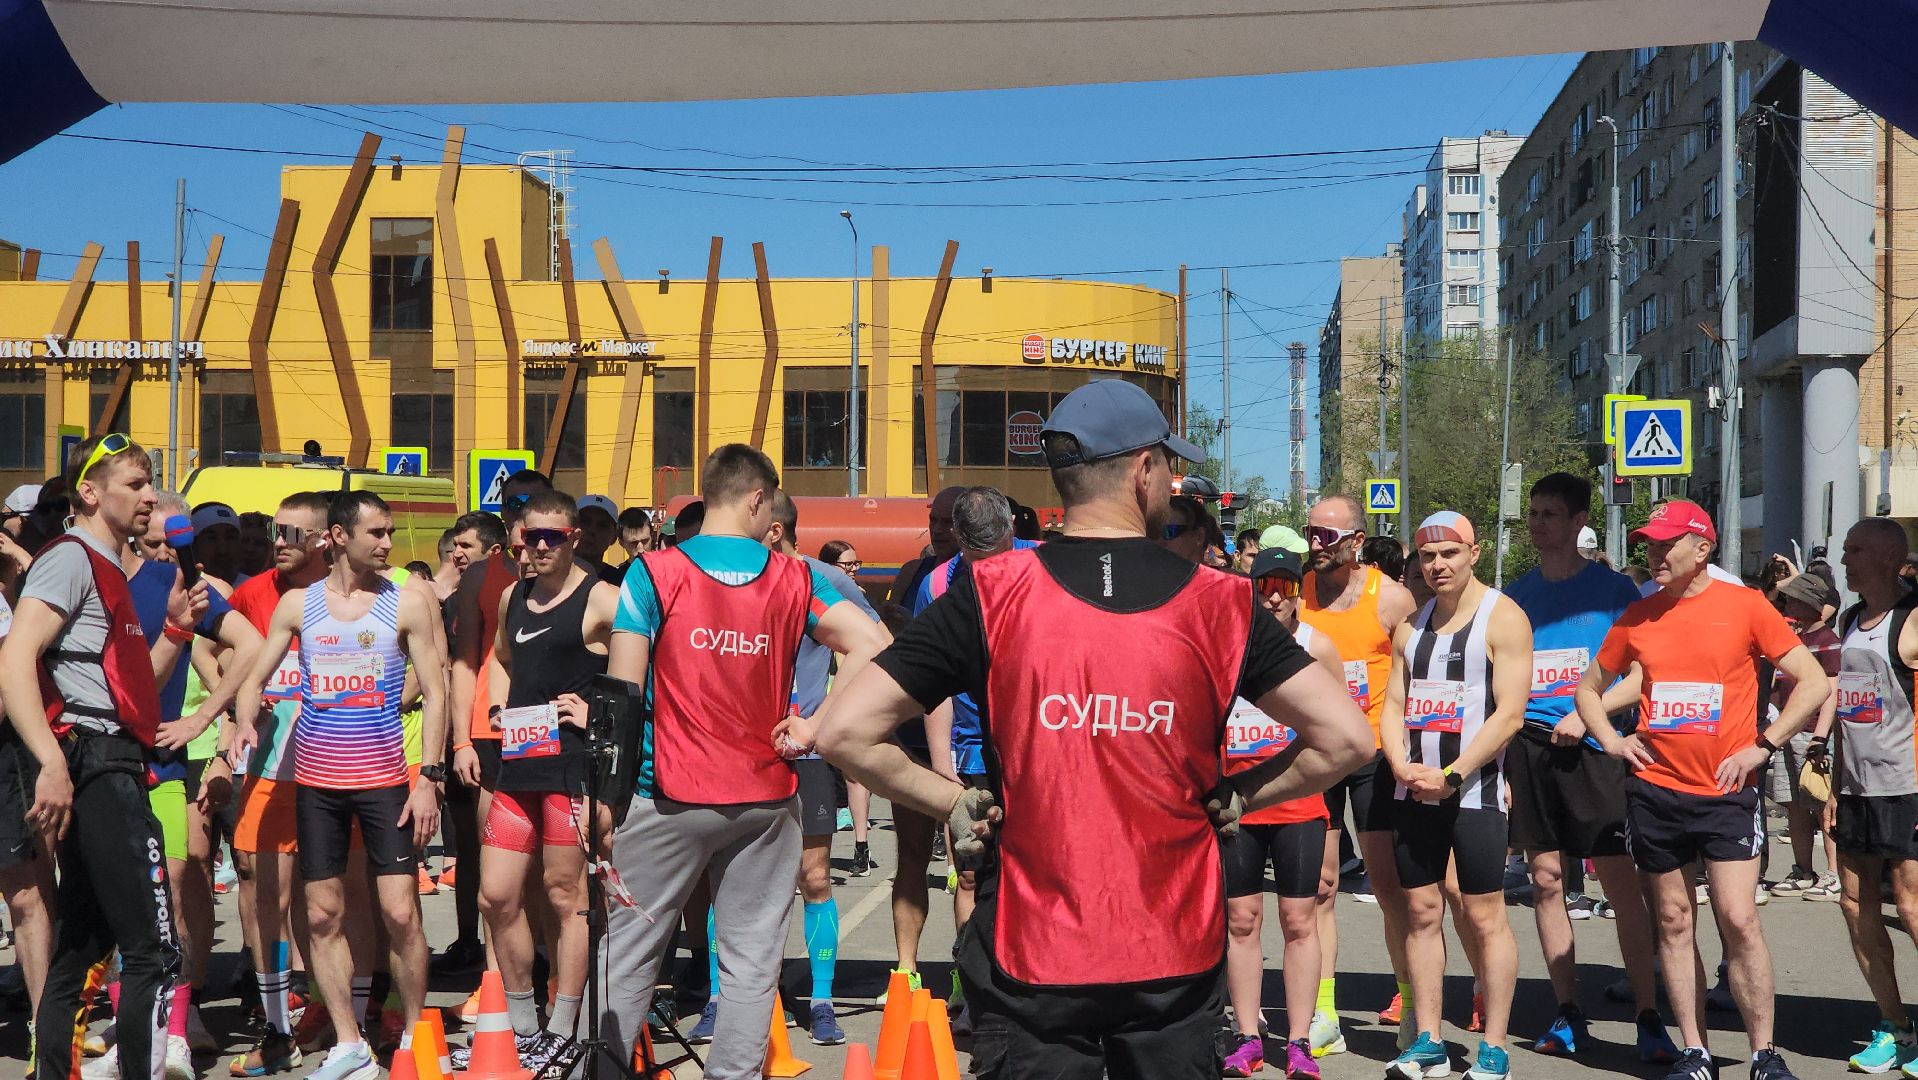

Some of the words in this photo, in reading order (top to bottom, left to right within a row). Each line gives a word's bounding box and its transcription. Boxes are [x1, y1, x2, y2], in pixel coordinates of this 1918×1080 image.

[524, 340, 577, 357] Яндекс
[601, 340, 657, 356] Маркет
[1051, 338, 1128, 362] БУРГЕР
[1135, 343, 1169, 366] КИНГ
[1103, 563, 1113, 597] Reebok
[690, 627, 769, 656] СУДЬЯ
[323, 675, 376, 692] 1008
[1537, 667, 1581, 684] 1045
[1414, 699, 1456, 717] 1044
[1845, 691, 1876, 706] 1042
[1040, 694, 1175, 737] СУДЬЯ
[1661, 701, 1711, 720] 1053
[510, 726, 550, 744] 1052
[1238, 724, 1288, 743] 1043
[147, 837, 161, 863] GO
[153, 888, 172, 942] SPORT
